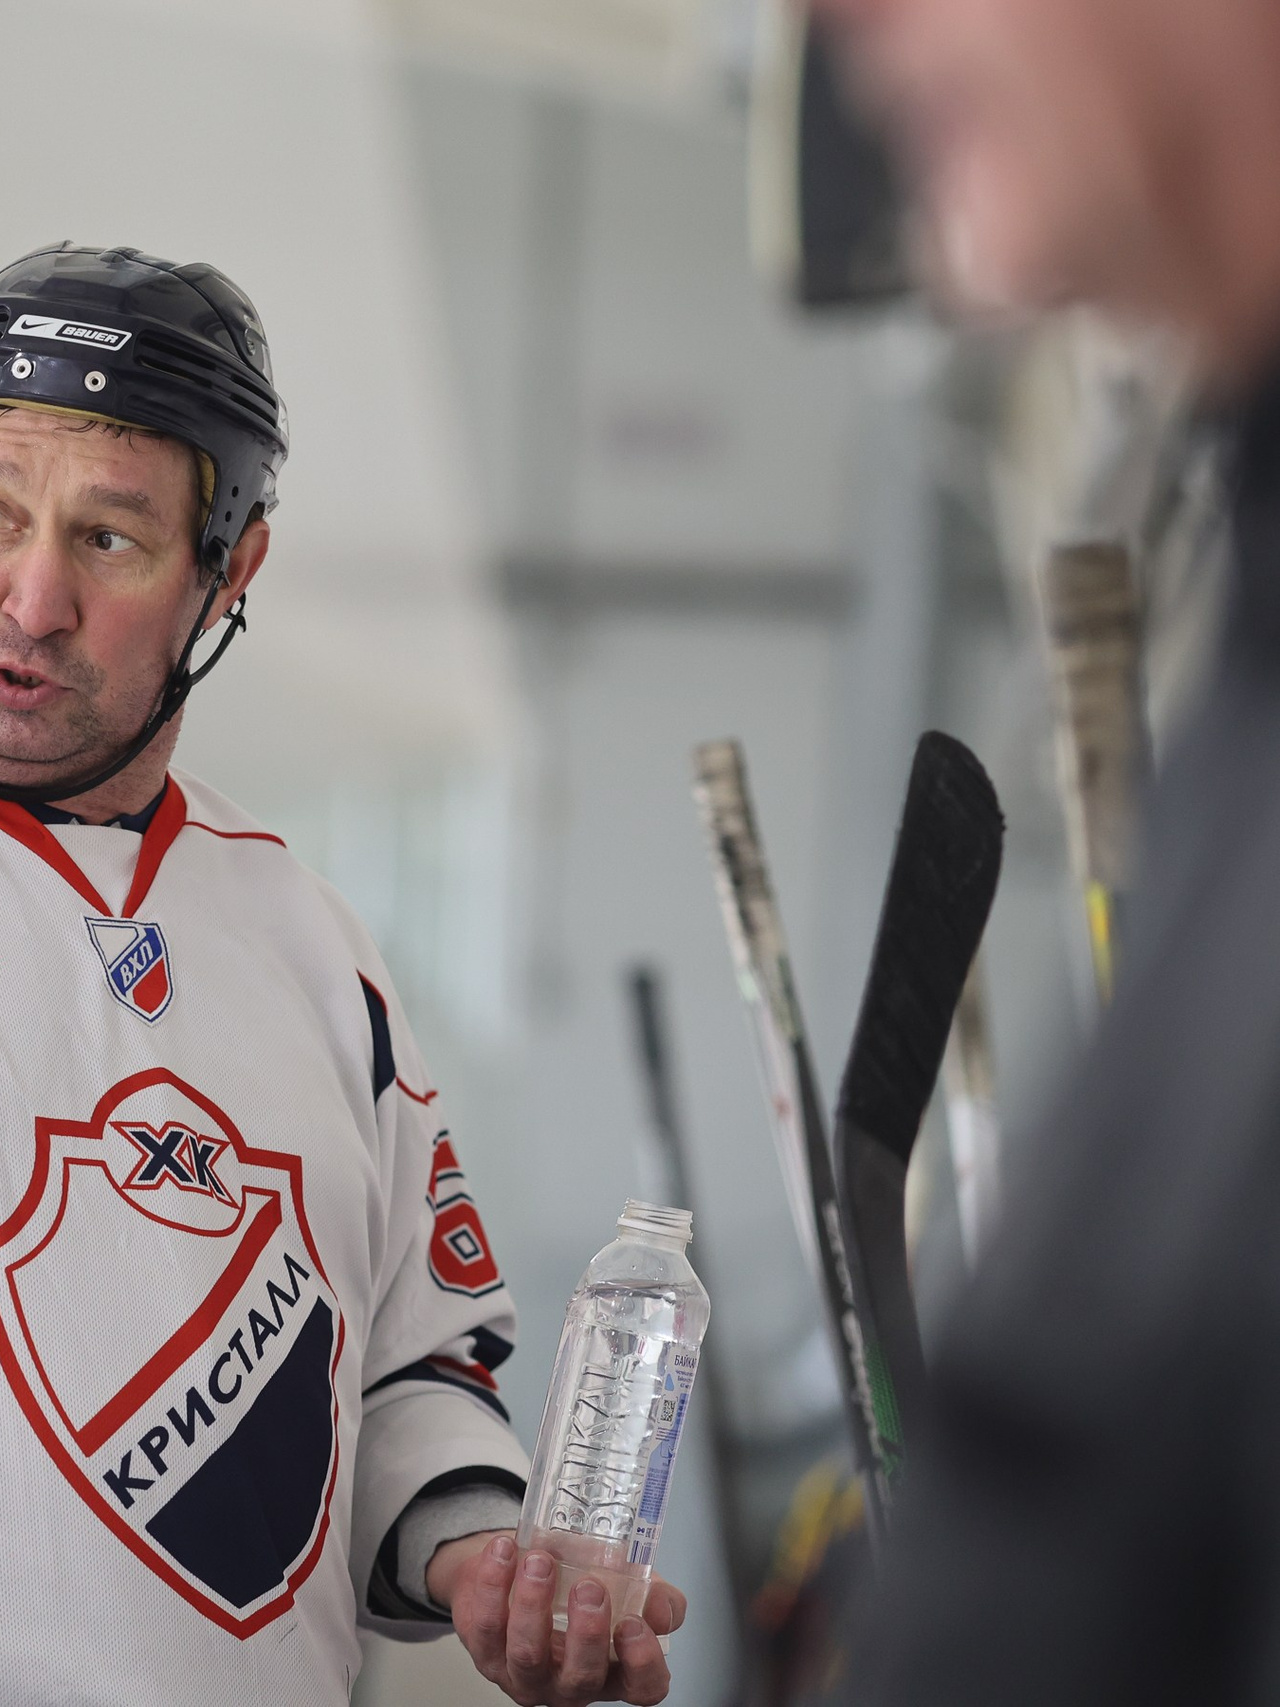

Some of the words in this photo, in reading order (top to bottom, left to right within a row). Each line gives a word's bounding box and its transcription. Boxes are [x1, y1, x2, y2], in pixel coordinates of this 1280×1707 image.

[119, 940, 154, 989] ВХЛ
[119, 1126, 233, 1203] ХК
[102, 1252, 311, 1510] КРИСТАЛЛ
